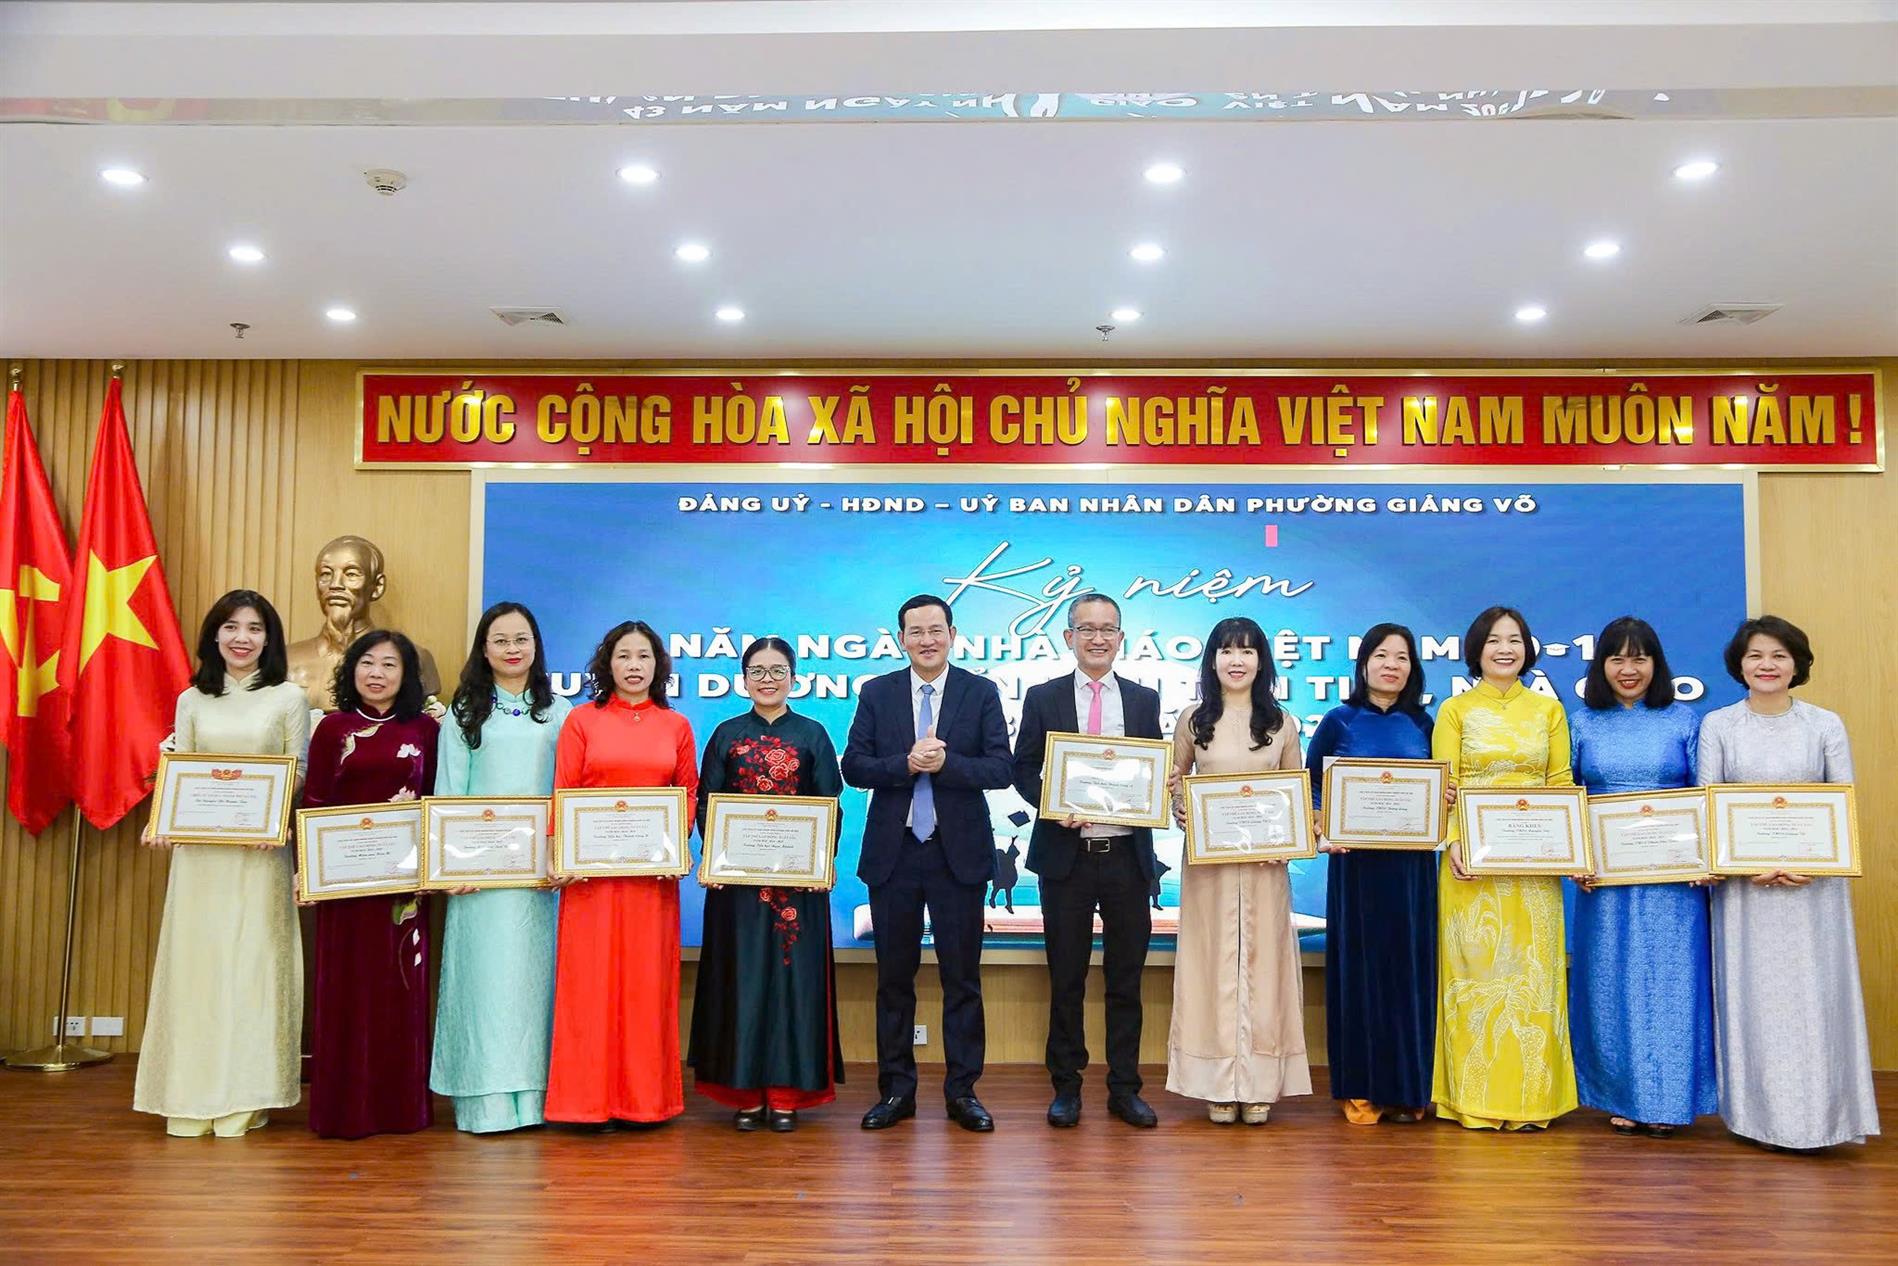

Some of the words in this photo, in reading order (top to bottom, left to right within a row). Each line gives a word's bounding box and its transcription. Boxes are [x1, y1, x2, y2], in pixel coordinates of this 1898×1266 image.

[377, 381, 515, 443] NƯỚC
[537, 383, 671, 455] CỘNG
[693, 382, 790, 443] HÒA
[807, 385, 876, 443] XÃ
[894, 383, 973, 456] HỘI
[990, 377, 1088, 444] CHỦ
[1106, 385, 1261, 446] NGHĨA
[1278, 384, 1384, 457] VIỆT
[1403, 396, 1524, 445] NAM
[1543, 383, 1693, 444] MUÔN
[1712, 383, 1836, 444] NĂM
[678, 493, 761, 512] ĐẢNG
[842, 497, 925, 512] HĐND
[1009, 497, 1069, 512] BAN
[1079, 494, 1163, 513] NHÂN
[1173, 494, 1236, 513] DÂN
[1247, 493, 1376, 513] PHƯỜNG
[1387, 493, 1483, 513] GIẢNG
[1493, 494, 1537, 513] VÕ
[1123, 566, 1313, 605] niệm
[798, 627, 908, 659] NGÀ
